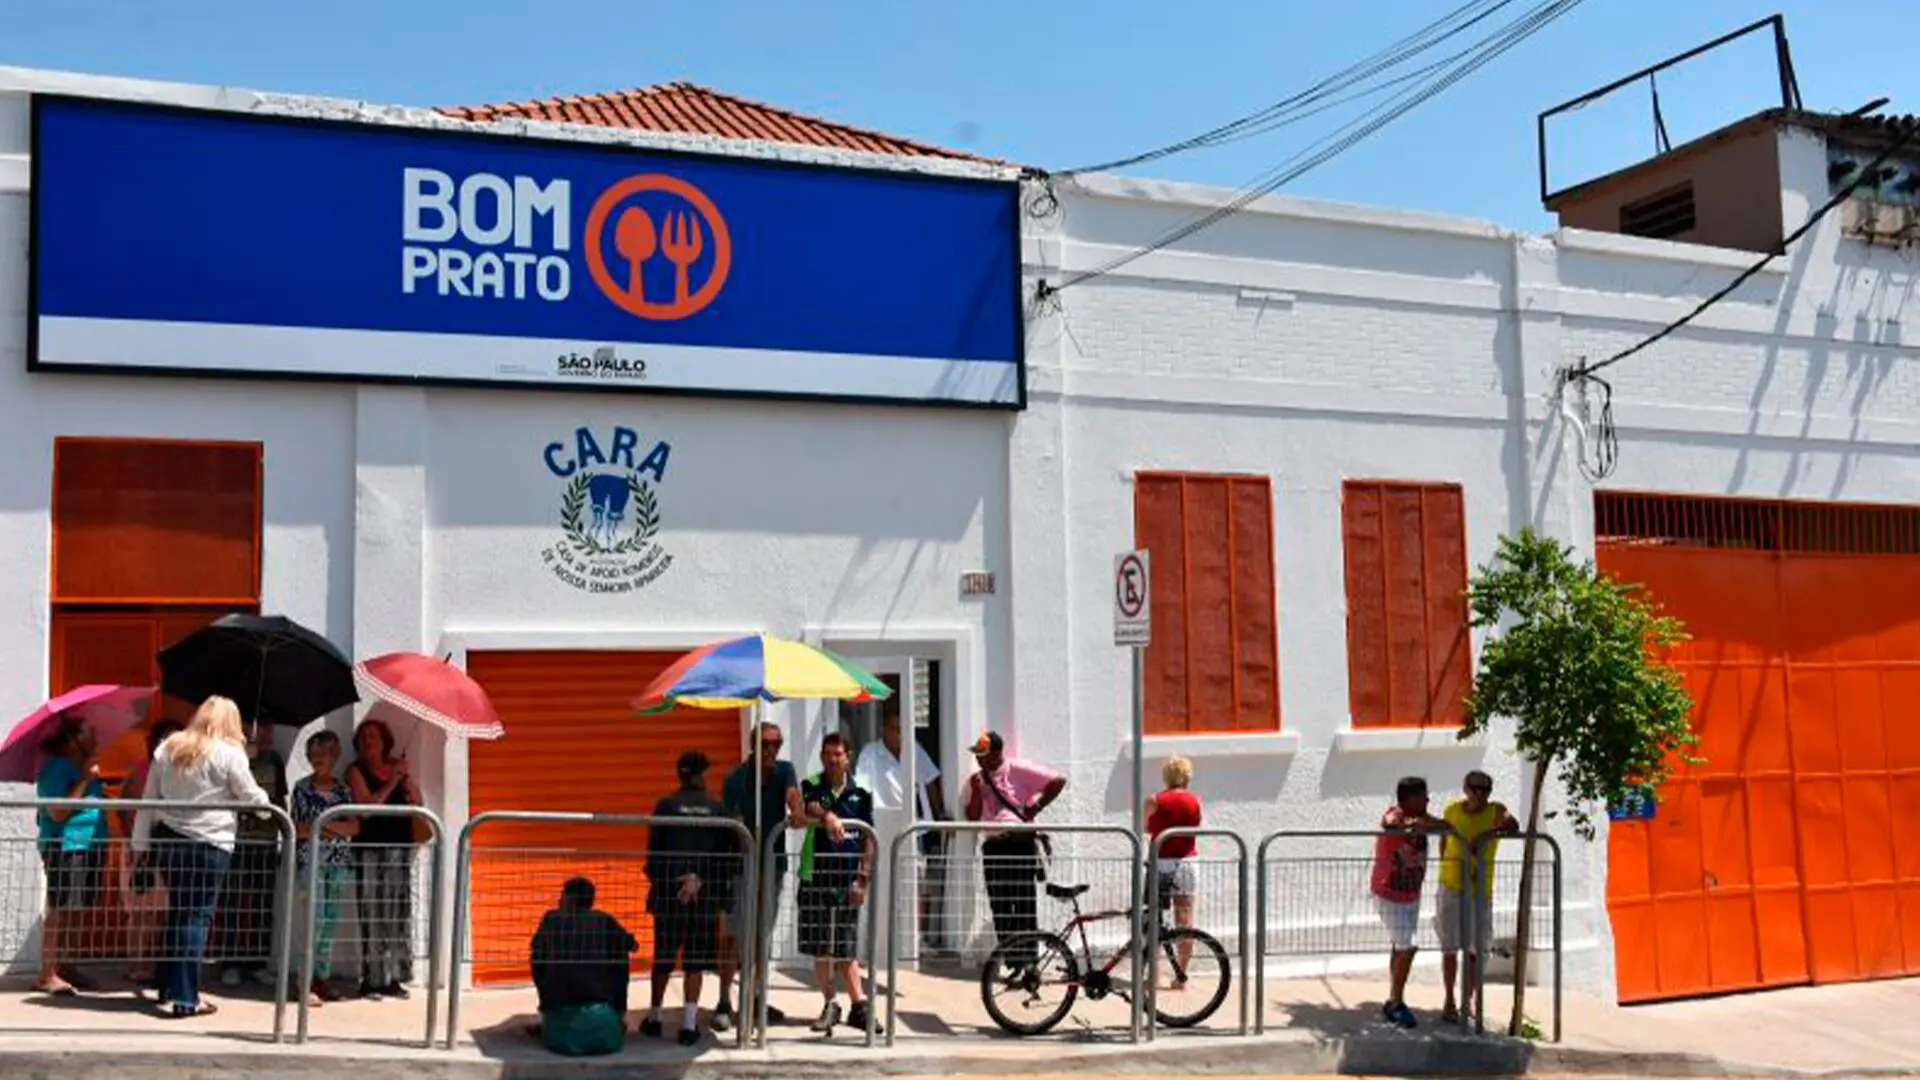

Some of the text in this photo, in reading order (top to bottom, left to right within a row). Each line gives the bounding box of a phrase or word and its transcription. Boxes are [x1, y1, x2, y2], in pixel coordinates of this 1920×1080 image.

[403, 167, 570, 250] BOM
[402, 246, 570, 301] PRATO
[557, 352, 646, 372] SÃO PAULO
[543, 425, 671, 483] CARA
